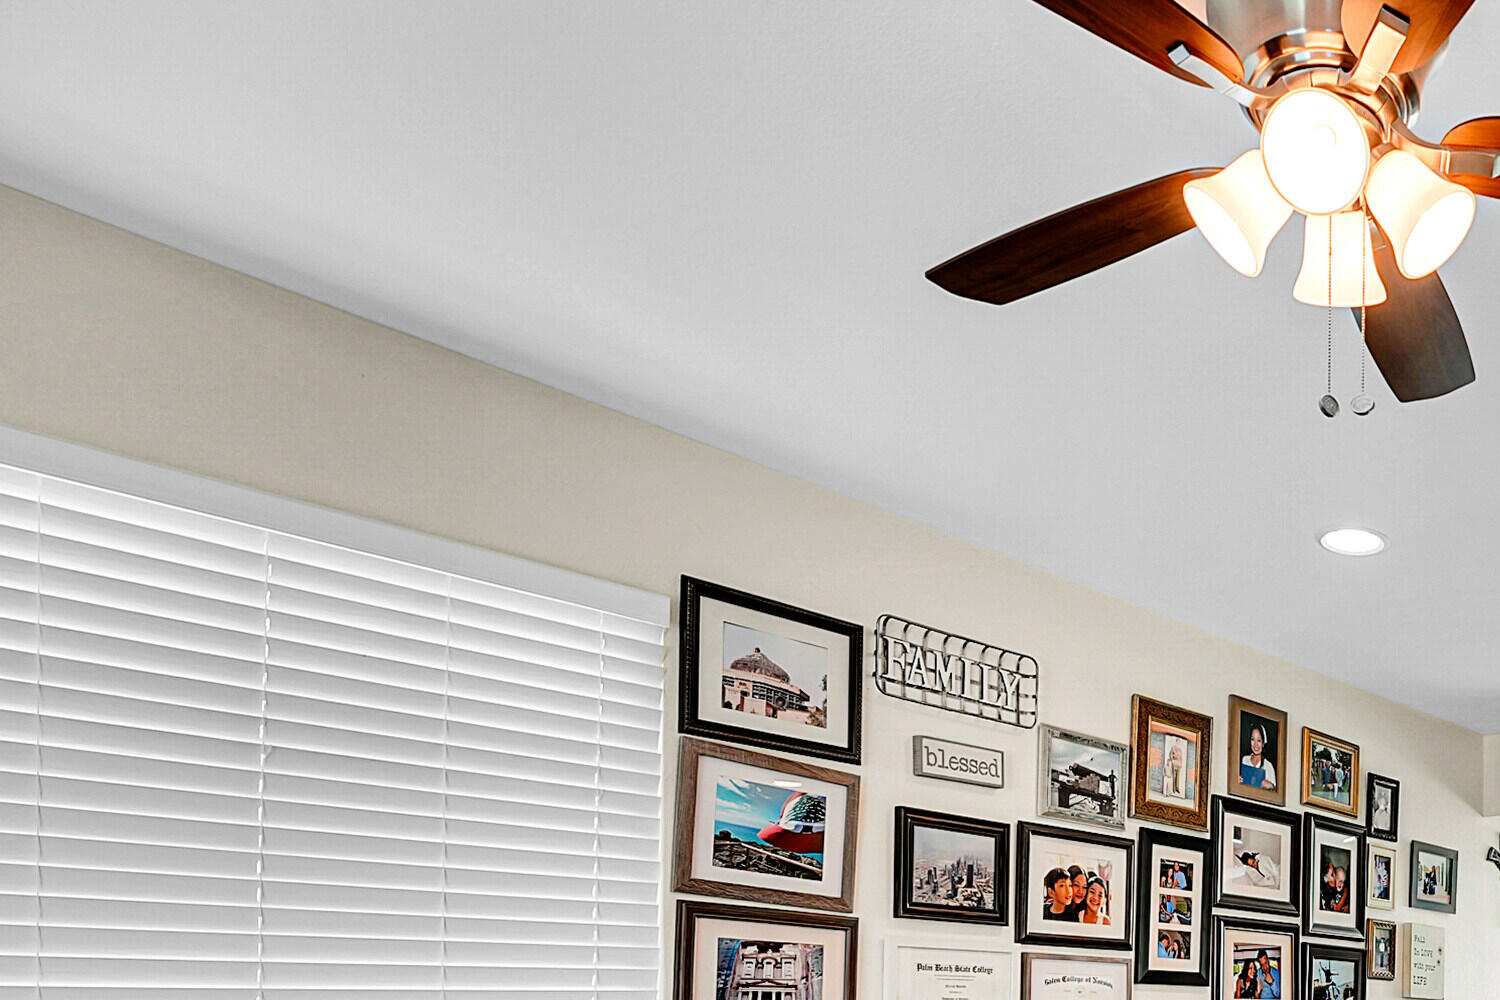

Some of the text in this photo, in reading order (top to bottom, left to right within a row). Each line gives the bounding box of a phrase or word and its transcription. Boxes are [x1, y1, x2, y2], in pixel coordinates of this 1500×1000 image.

[881, 635, 1022, 712] FAMILY
[924, 745, 1000, 778] blessed
[917, 963, 993, 975] Palm Beach State College
[1062, 975, 1083, 984] College
